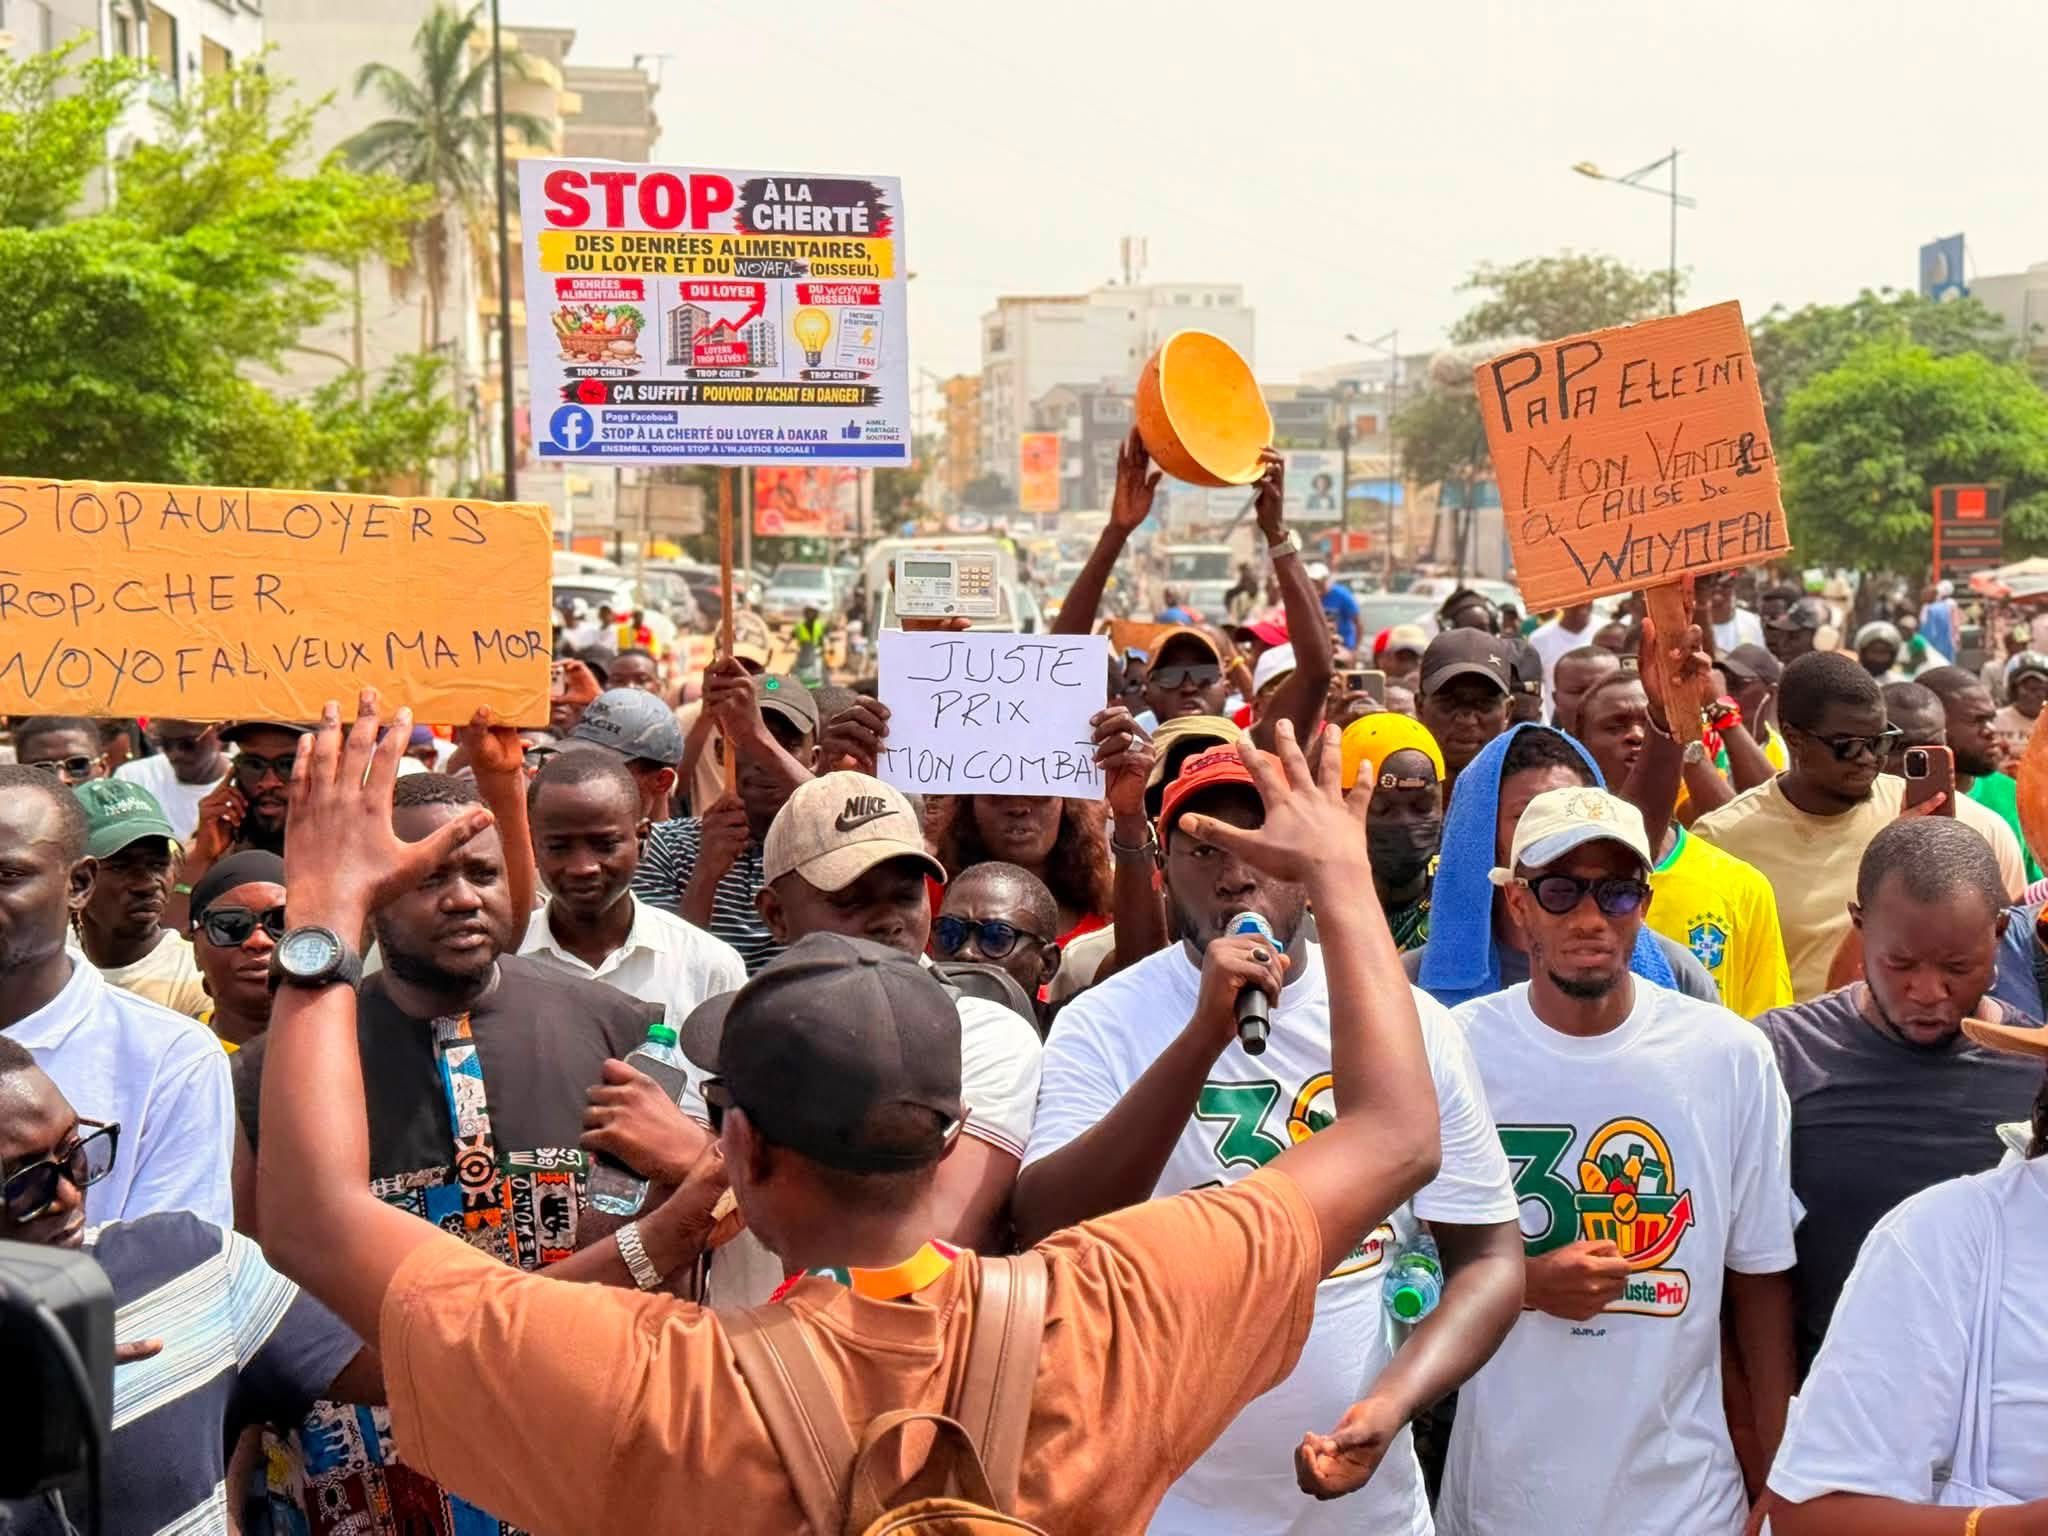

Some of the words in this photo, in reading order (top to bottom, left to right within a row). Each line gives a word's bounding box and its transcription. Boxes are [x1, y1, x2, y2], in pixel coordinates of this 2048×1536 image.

[544, 170, 734, 230] STOP
[764, 179, 780, 202] À
[785, 183, 812, 203] LA
[752, 201, 869, 233] CHERTÉ
[575, 235, 614, 252] DES
[622, 233, 713, 255] DENRÉES
[720, 239, 871, 262] ALIMENTAIRES,
[566, 254, 594, 271] DU
[602, 255, 667, 272] LOYER
[673, 257, 697, 273] ET
[703, 258, 730, 274] DU
[735, 259, 801, 277] WOYAFAL
[810, 263, 880, 278] (DISSEUL)
[690, 285, 709, 298] DU
[712, 285, 755, 298] LOYER
[808, 285, 824, 295] DU
[810, 294, 861, 305] (DISSEUL)
[576, 368, 598, 377] TROP
[696, 369, 718, 378] TROP
[719, 370, 741, 378] CHER
[810, 371, 832, 380] TROP
[613, 385, 634, 403] ÇA
[638, 385, 689, 401] SUFFIT
[703, 386, 753, 402] POUVOIR
[755, 387, 800, 403] D'ACHAT
[801, 388, 815, 403] EN
[817, 388, 859, 403] DANGER
[606, 413, 628, 424] Page
[601, 428, 634, 440] STOP
[637, 425, 646, 440] À
[649, 428, 664, 440] LA
[667, 425, 713, 441] CHERTÉ
[716, 428, 733, 441] DU
[738, 428, 775, 441] LOYER
[777, 425, 785, 441] À
[788, 429, 827, 442] DAKAR
[688, 446, 709, 454] STOP
[774, 446, 809, 455] SOCIALE
[1576, 482, 1684, 530] CAUSE
[1560, 510, 1789, 587] WOYOFAL
[386, 629, 460, 671] MA
[907, 641, 1084, 687] JUSTE
[930, 690, 1030, 729] PRIX
[843, 795, 887, 818] NIKE
[1622, 1280, 1684, 1304] ustePrix
